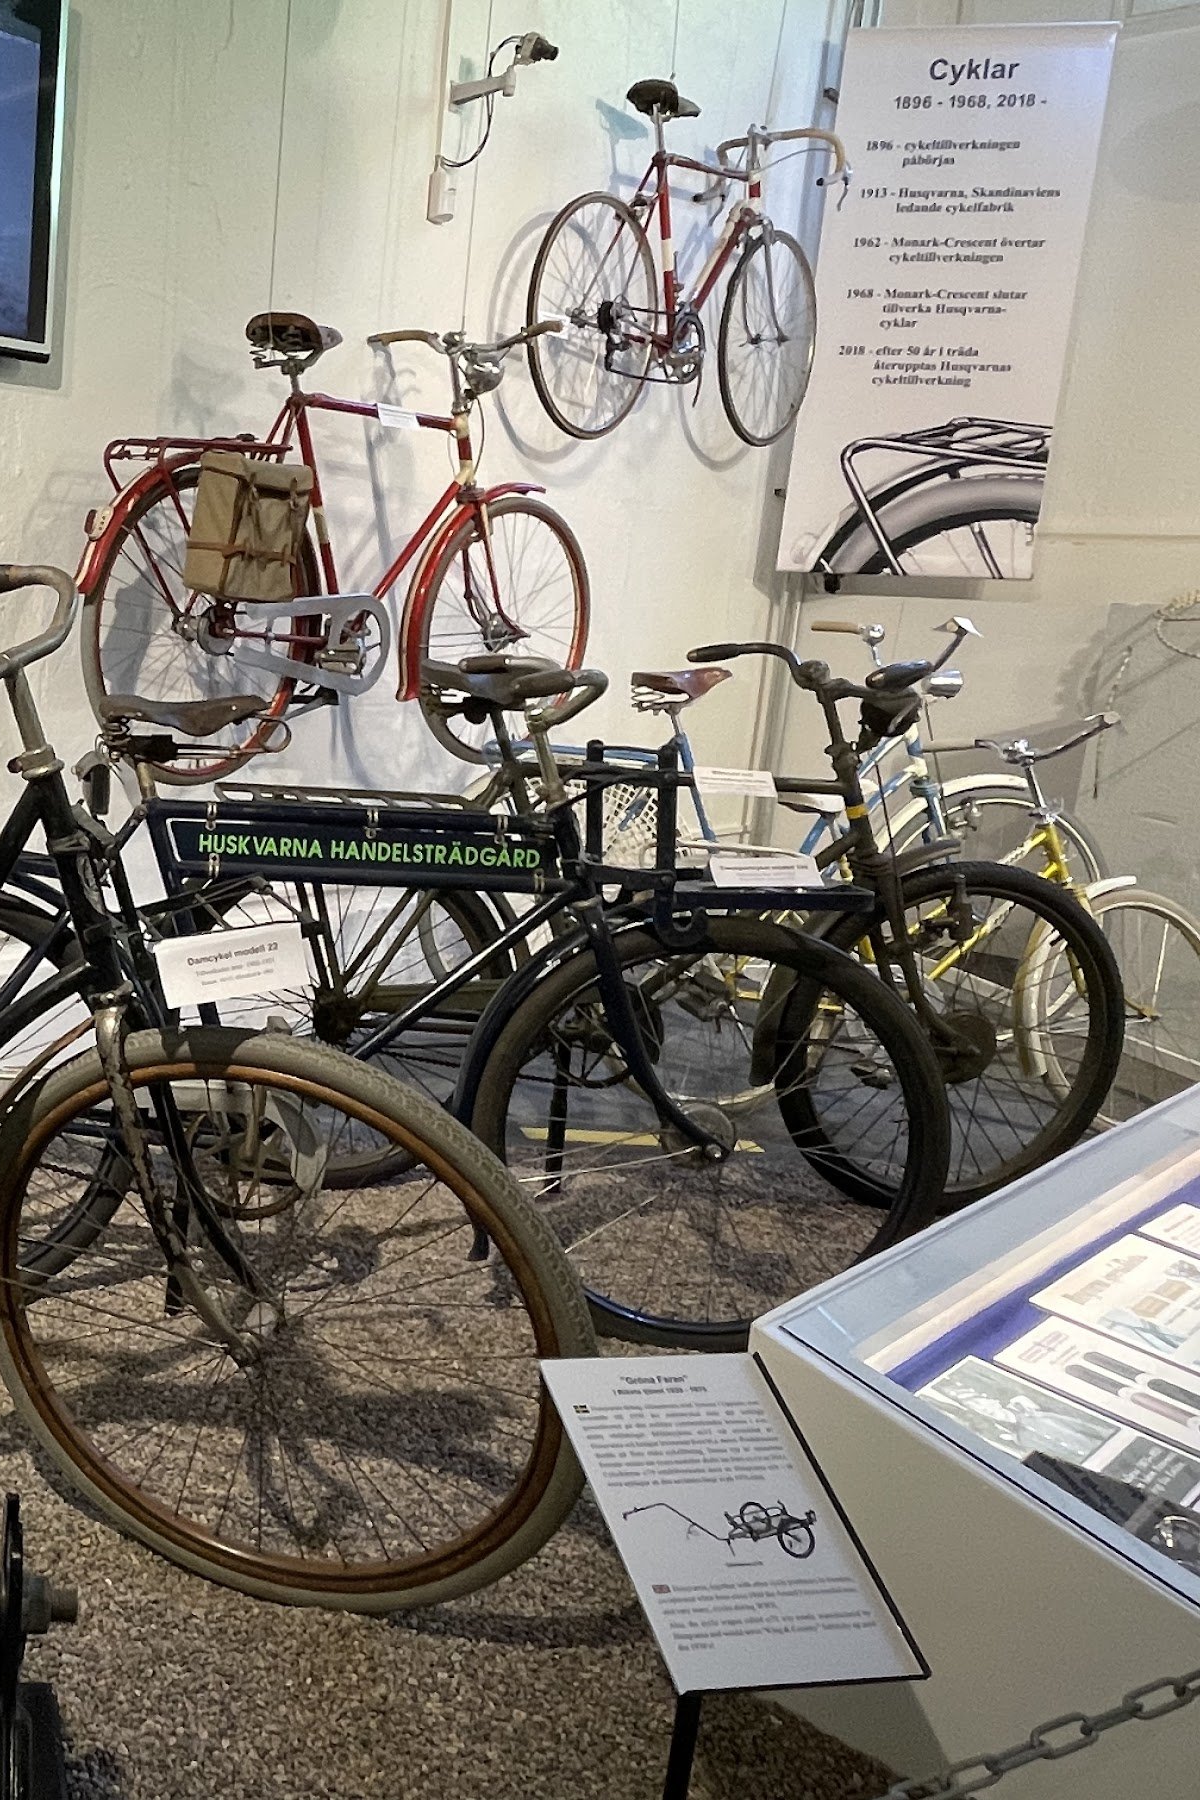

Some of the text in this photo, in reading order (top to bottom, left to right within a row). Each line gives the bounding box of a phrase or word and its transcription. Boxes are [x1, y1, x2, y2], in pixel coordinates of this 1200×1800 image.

[929, 57, 1021, 86] Cyklar
[894, 95, 933, 110] 1896
[949, 94, 992, 110] 1968,
[996, 94, 1037, 109] 2018
[866, 140, 893, 151] 1896
[904, 139, 1021, 151] cykeltillverkningen
[902, 154, 955, 168] påbörjas
[860, 188, 888, 199] 1913
[898, 187, 968, 201] Husqvarna,
[971, 187, 1060, 199] Skandinaviens
[895, 201, 1014, 215] ledande cykelfabrik
[853, 237, 882, 248] 1962
[891, 237, 998, 248] Monark-Crescent
[1000, 236, 1046, 248] övertar
[889, 252, 1004, 265] cykeltillverkningen
[846, 289, 875, 299] 1968
[883, 289, 990, 300] Monark-Crescent
[992, 289, 1028, 300] slutar
[882, 304, 1007, 317] tillverka Husqvarna-
[879, 318, 917, 330] cyklar
[838, 346, 866, 356] 2018
[875, 345, 903, 357] efter
[907, 346, 921, 356] 50
[923, 345, 936, 357] år
[946, 346, 979, 357] träda
[873, 360, 1012, 374] återupptas Husqvarnas
[871, 375, 971, 388] cykeltillverkning
[198, 834, 542, 869] HUSKVARNA HANDELSTRÄDGÅRD
[187, 951, 232, 966] Damcykel
[234, 944, 265, 957] modell
